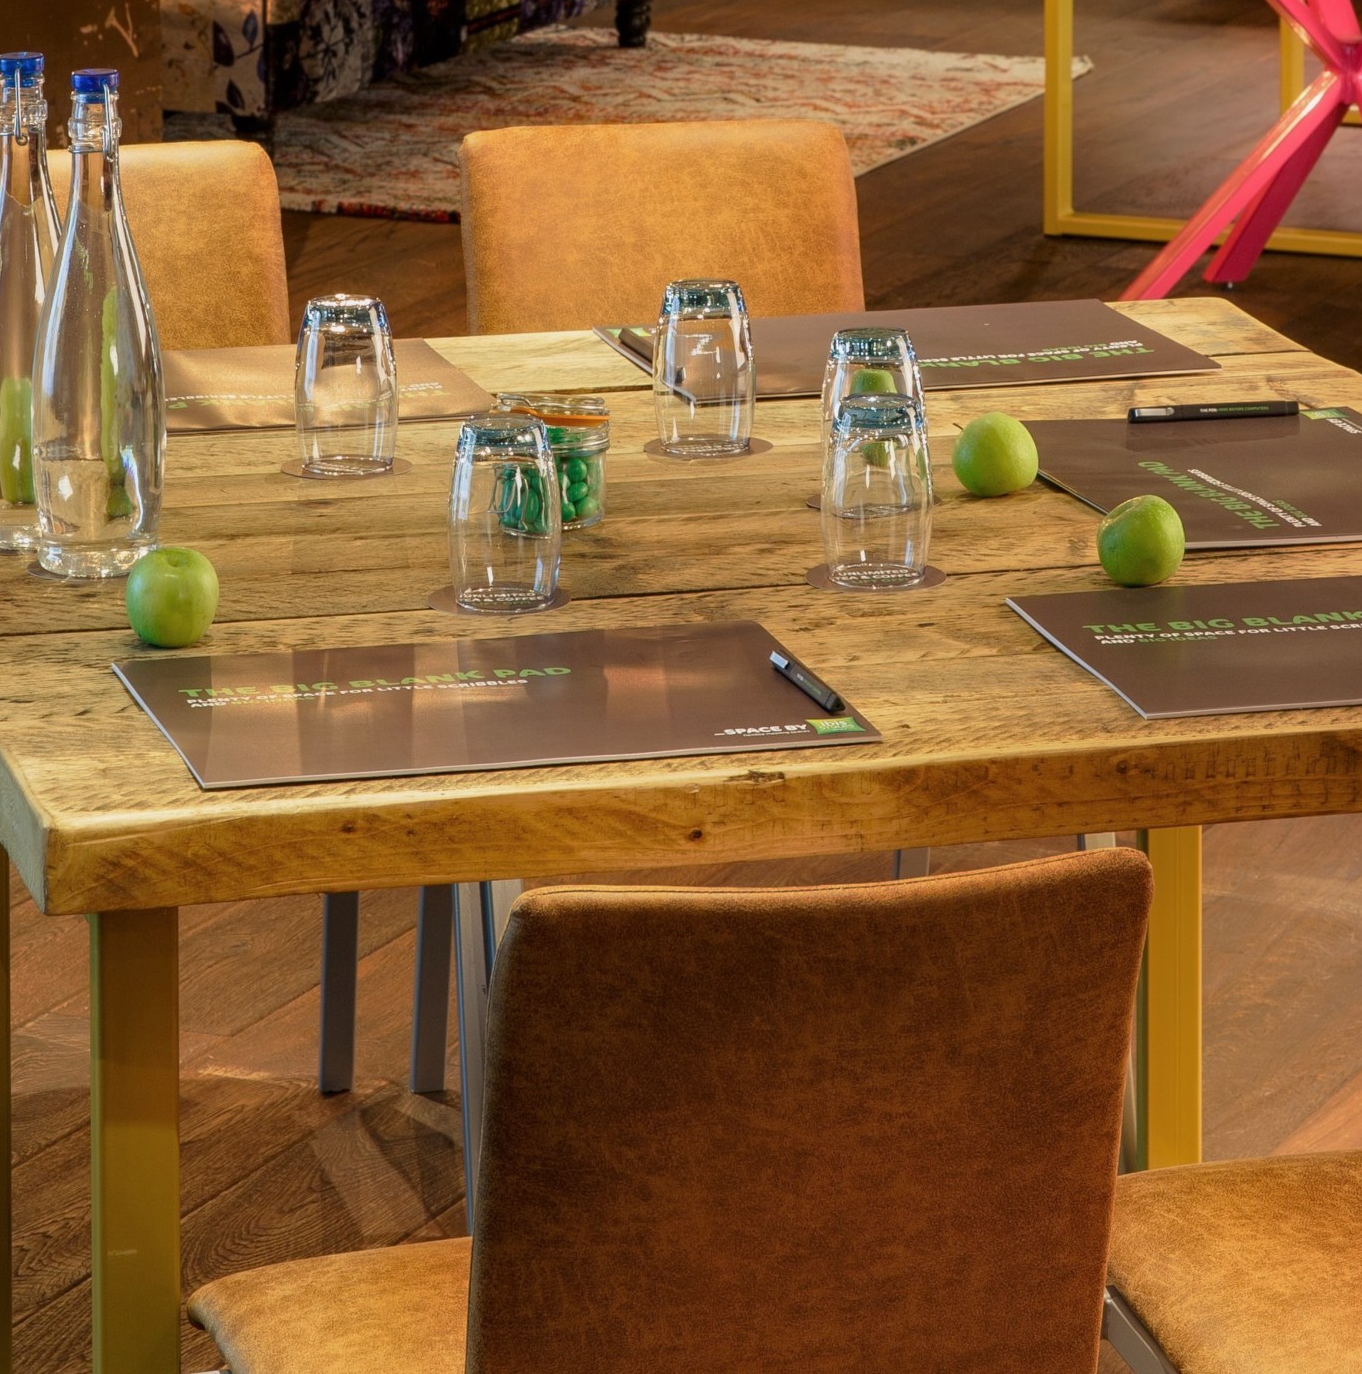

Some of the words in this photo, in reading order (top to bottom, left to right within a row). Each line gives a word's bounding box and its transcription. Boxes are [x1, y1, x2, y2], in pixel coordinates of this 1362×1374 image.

[1210, 497, 1252, 511] BIG
[1235, 510, 1280, 529] THE
[1082, 622, 1162, 634] THE
[1167, 618, 1235, 630] BIG
[1094, 632, 1155, 640] PLENTY
[1183, 629, 1236, 637] SPACE
[1239, 627, 1271, 635] FOR
[1273, 625, 1328, 633] LITTLE
[178, 686, 260, 698] THE
[269, 682, 339, 694] BIG
[349, 670, 486, 688] BLANK
[493, 667, 572, 678] PAD
[186, 696, 250, 704] PLENTY
[282, 691, 336, 699] SPACE
[340, 687, 373, 695] FOR
[377, 684, 434, 692] LITTLE
[437, 679, 529, 689] SCRIBBLES
